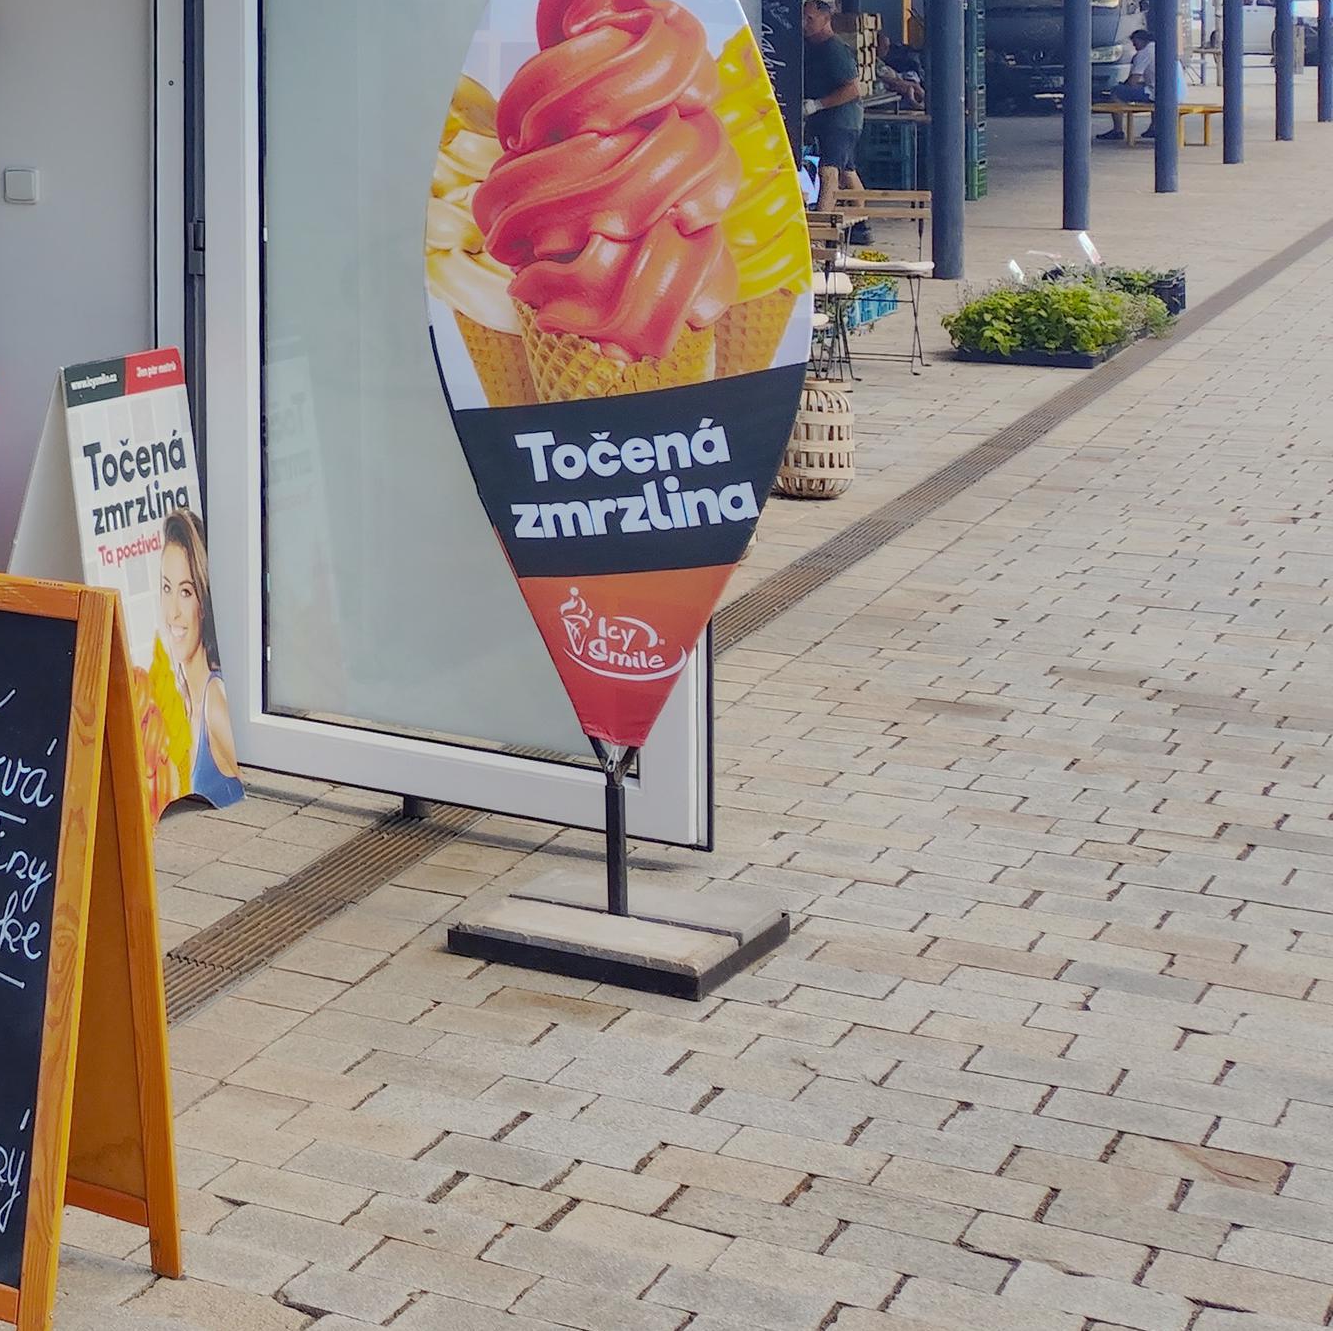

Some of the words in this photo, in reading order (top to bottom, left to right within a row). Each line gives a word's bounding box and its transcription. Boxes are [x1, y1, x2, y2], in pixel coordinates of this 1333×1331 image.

[83, 428, 188, 491] Točená
[514, 416, 732, 484] Točená
[92, 479, 190, 536] zmrzlina
[510, 475, 761, 540] zmrzlina
[98, 544, 114, 567] Ta
[586, 633, 667, 670] Smile
[597, 615, 640, 649] Icy
